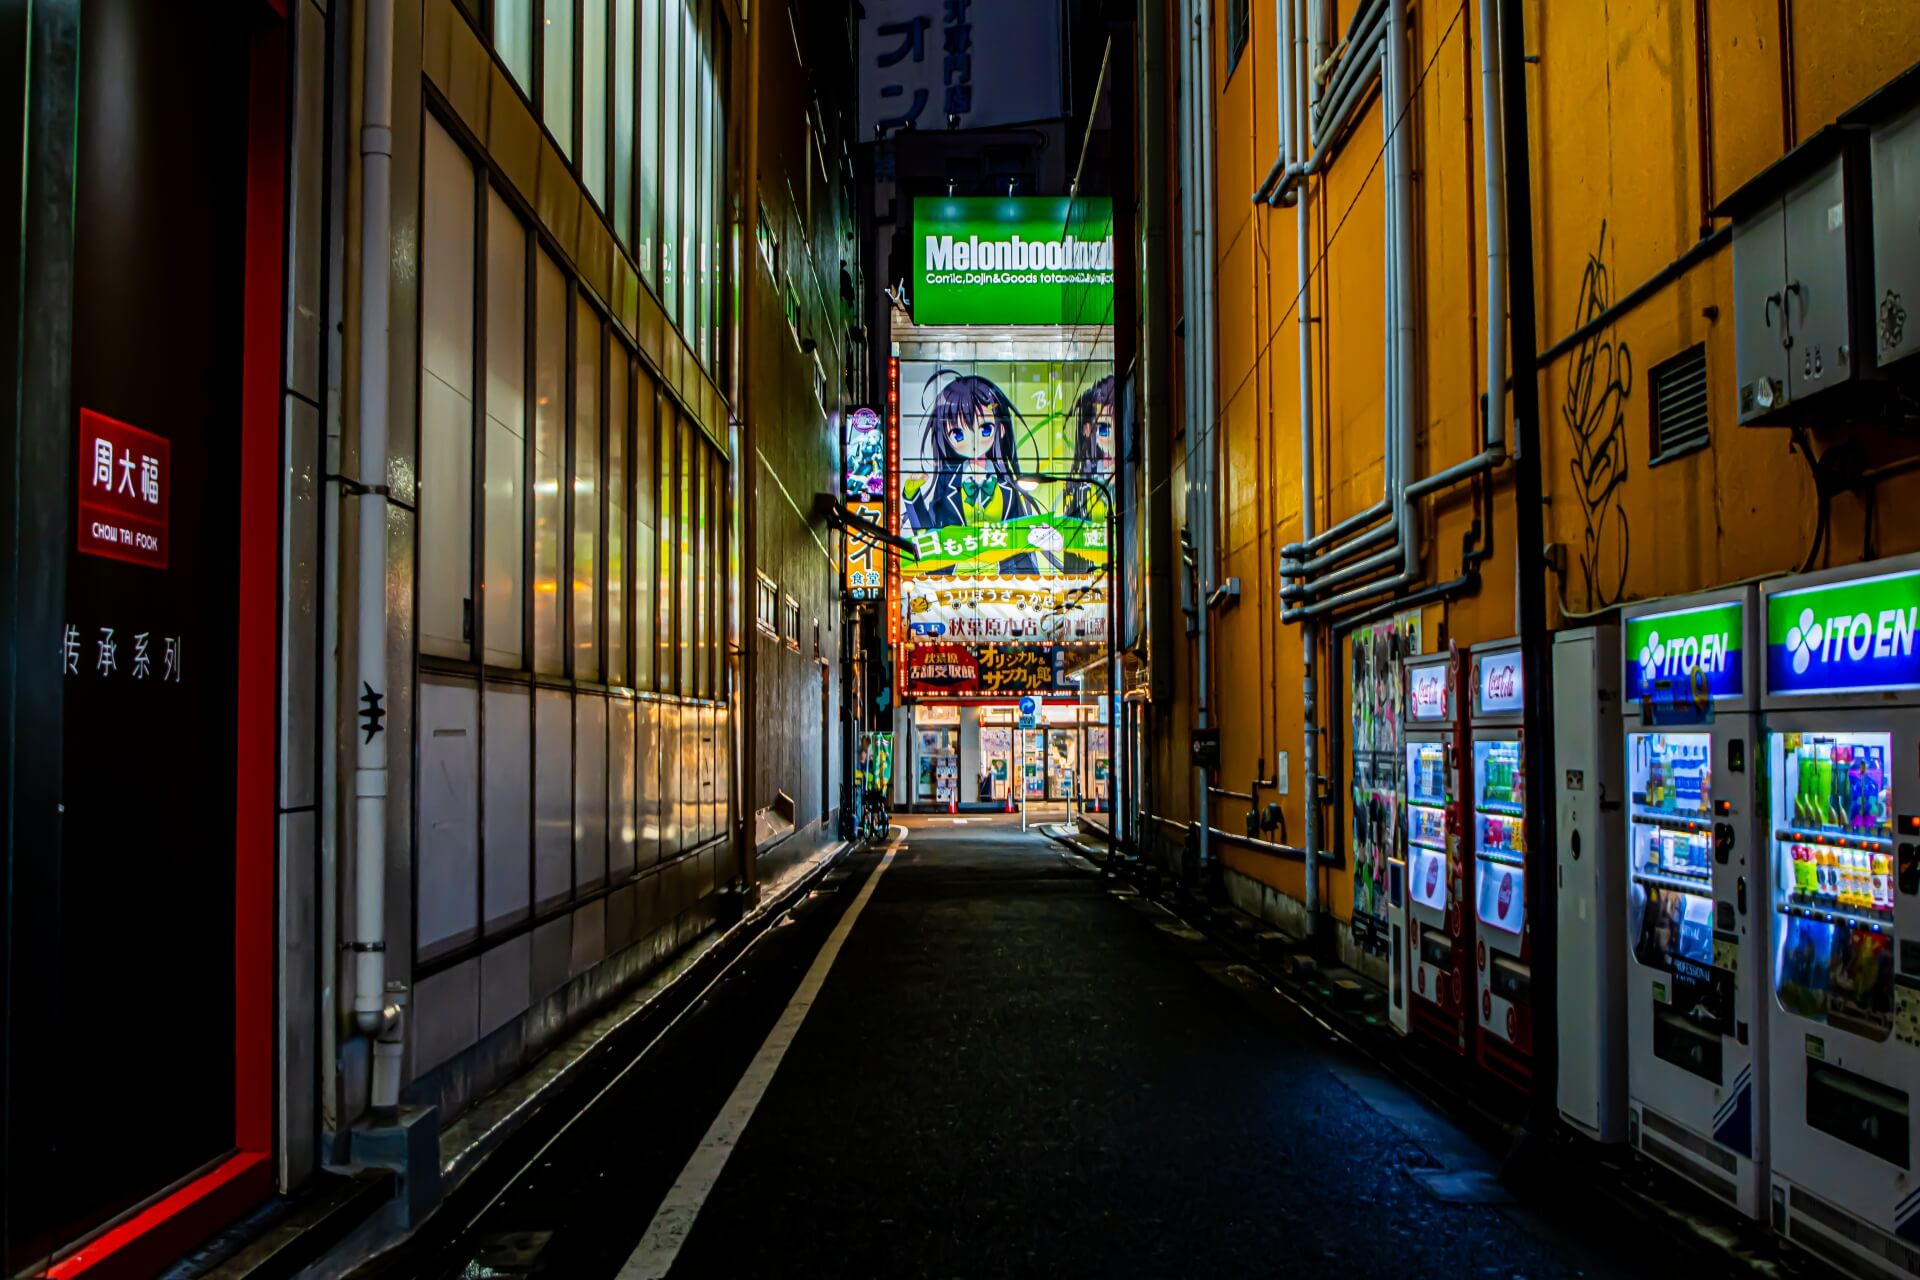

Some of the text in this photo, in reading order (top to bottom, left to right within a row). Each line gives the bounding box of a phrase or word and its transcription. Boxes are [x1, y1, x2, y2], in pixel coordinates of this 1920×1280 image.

[93, 438, 160, 504] 周大福
[92, 522, 158, 551] CHOW TAI FOOK
[850, 571, 880, 586] 食堂
[62, 624, 181, 683] 传承系列
[1699, 632, 1729, 673] EN
[1820, 607, 1918, 663] ITO EN
